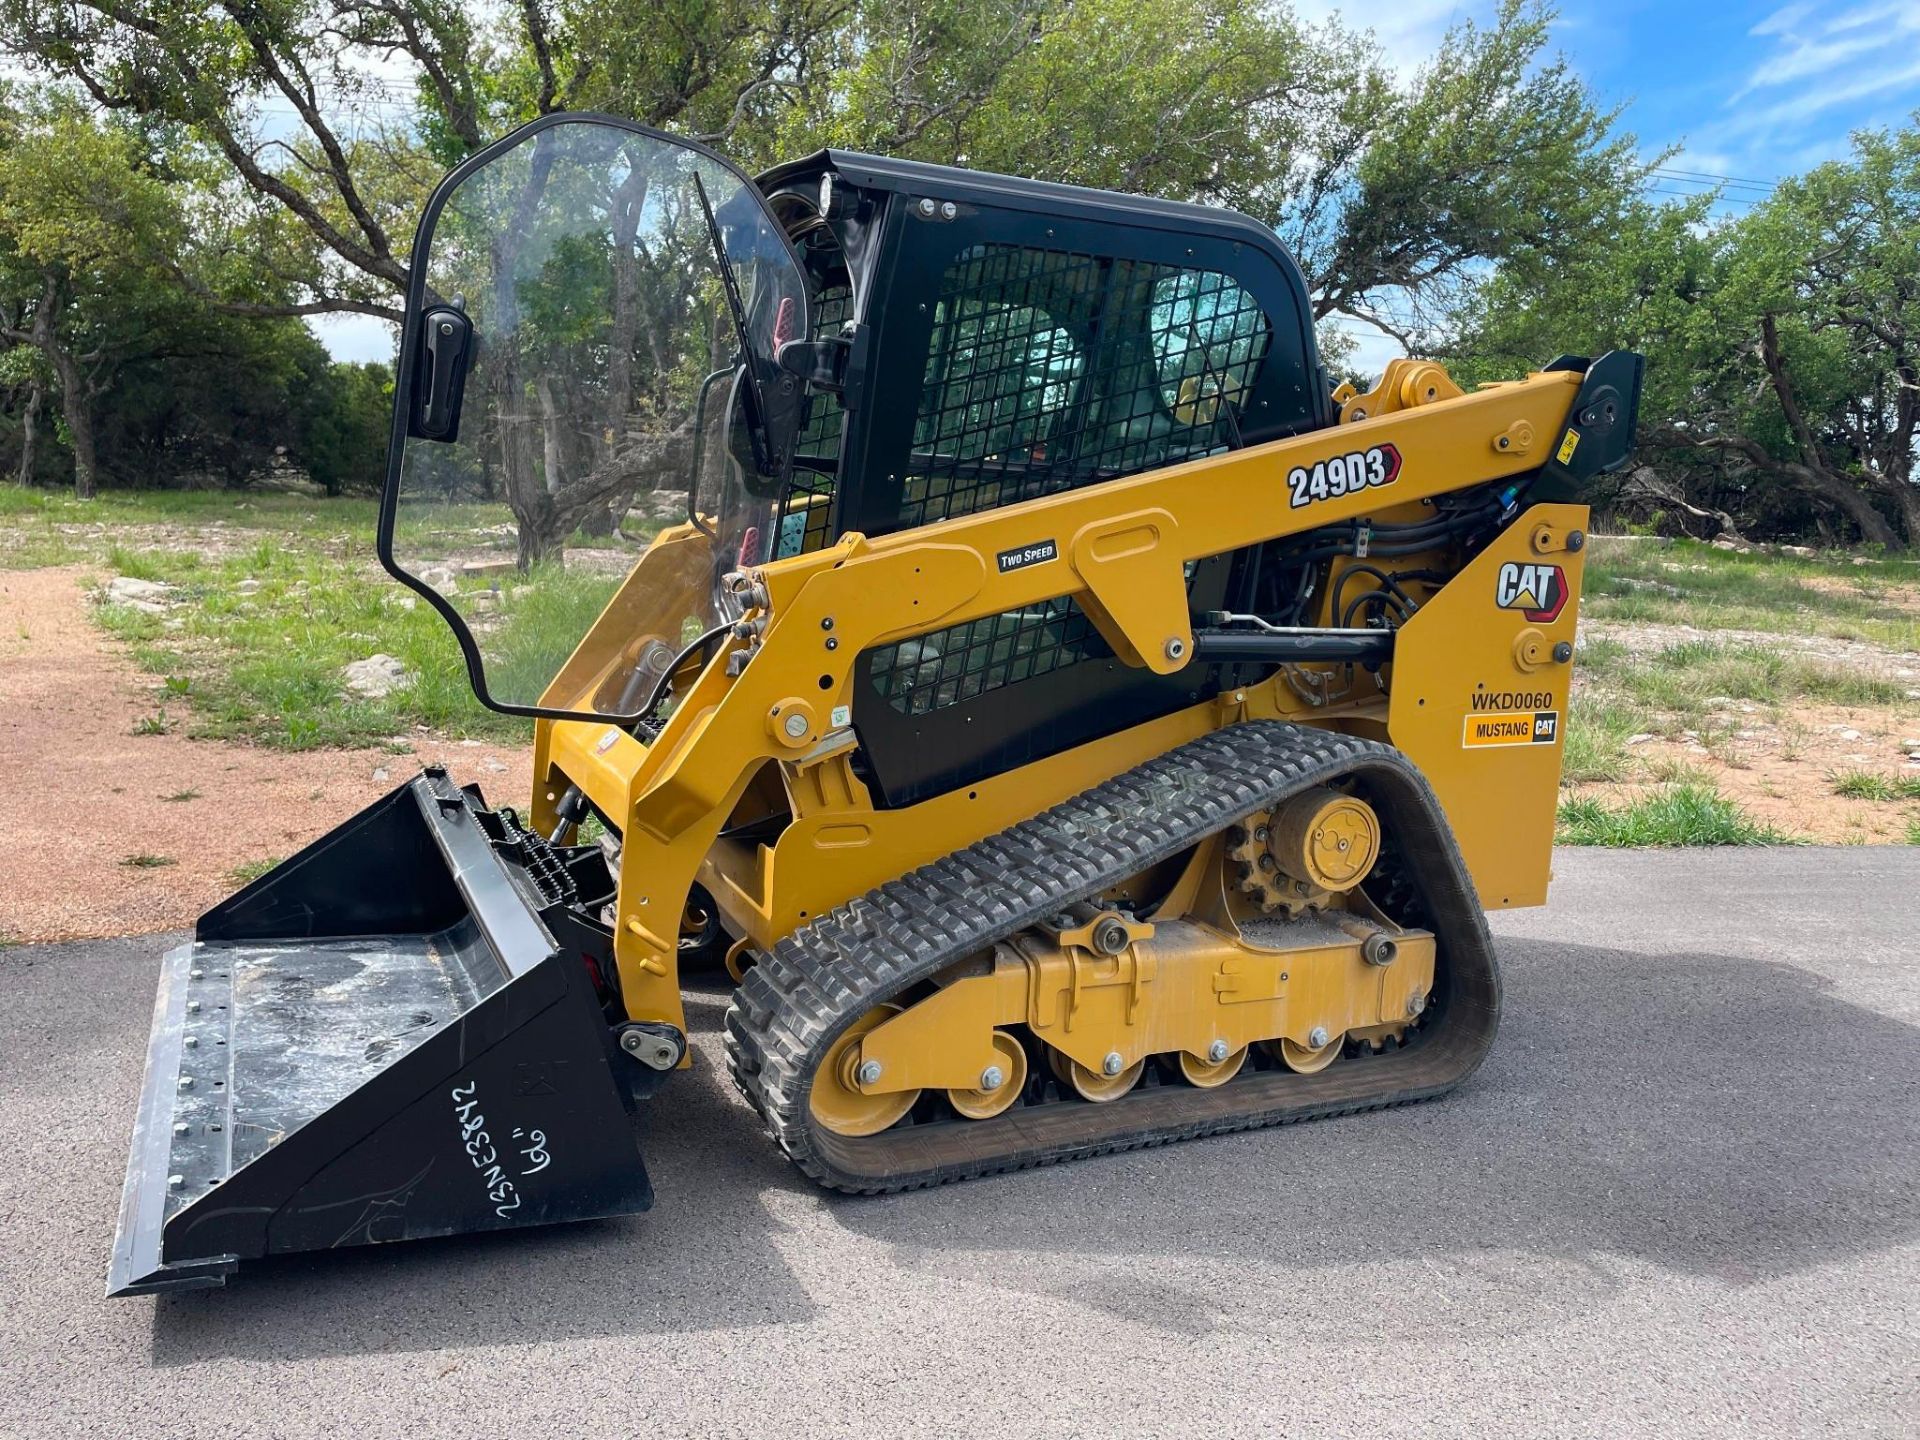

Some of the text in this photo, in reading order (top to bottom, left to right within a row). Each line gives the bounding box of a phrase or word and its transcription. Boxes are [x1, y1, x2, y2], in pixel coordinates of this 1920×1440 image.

[1289, 449, 1385, 507] 249D3
[1497, 563, 1554, 608] CAT
[1471, 692, 1553, 710] WKD0060
[1476, 719, 1554, 738] MUSTANG CAT
